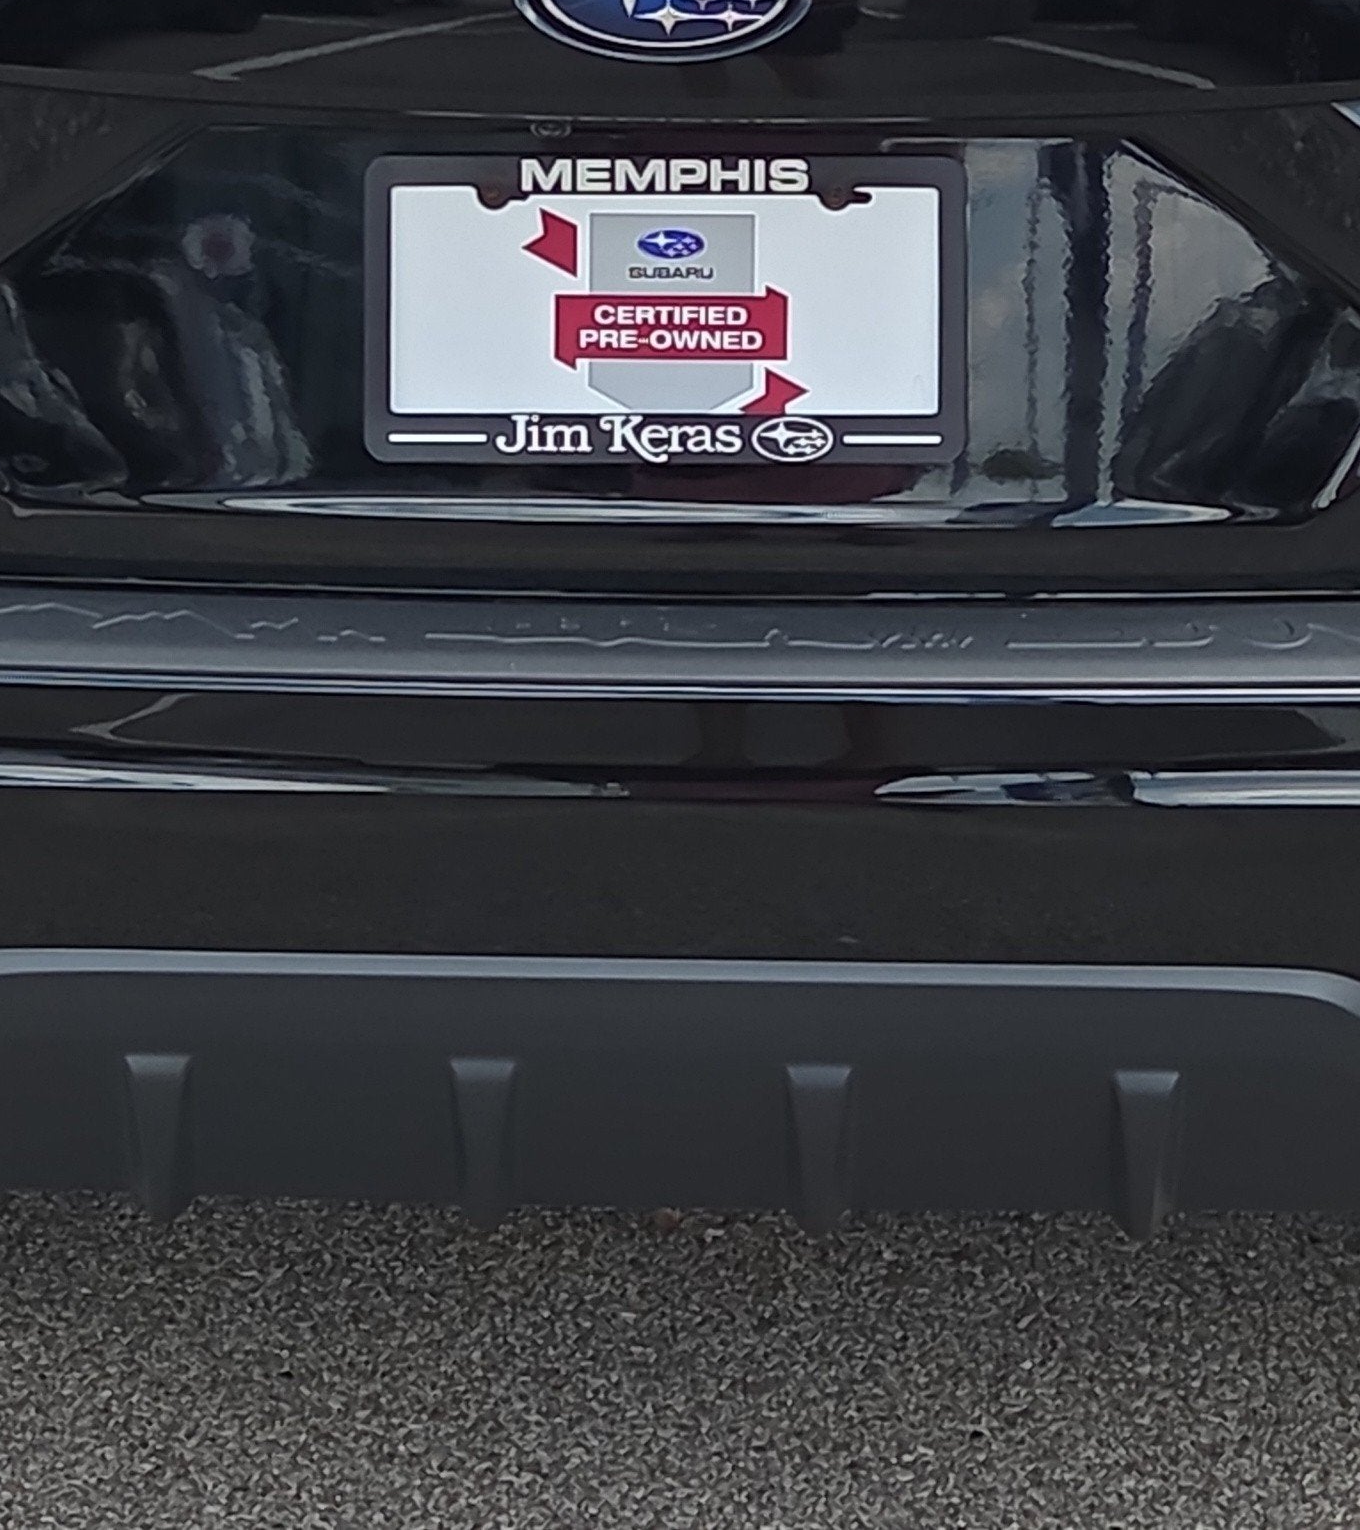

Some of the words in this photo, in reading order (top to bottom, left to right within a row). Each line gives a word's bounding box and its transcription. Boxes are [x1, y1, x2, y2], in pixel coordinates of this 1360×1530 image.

[520, 158, 810, 192] MEMPHIS
[628, 265, 714, 280] SUBARU
[593, 304, 748, 326] CERTIFIED
[578, 329, 763, 350] PRE-OWNED
[494, 415, 592, 455] Jim
[599, 416, 744, 462] Keras
